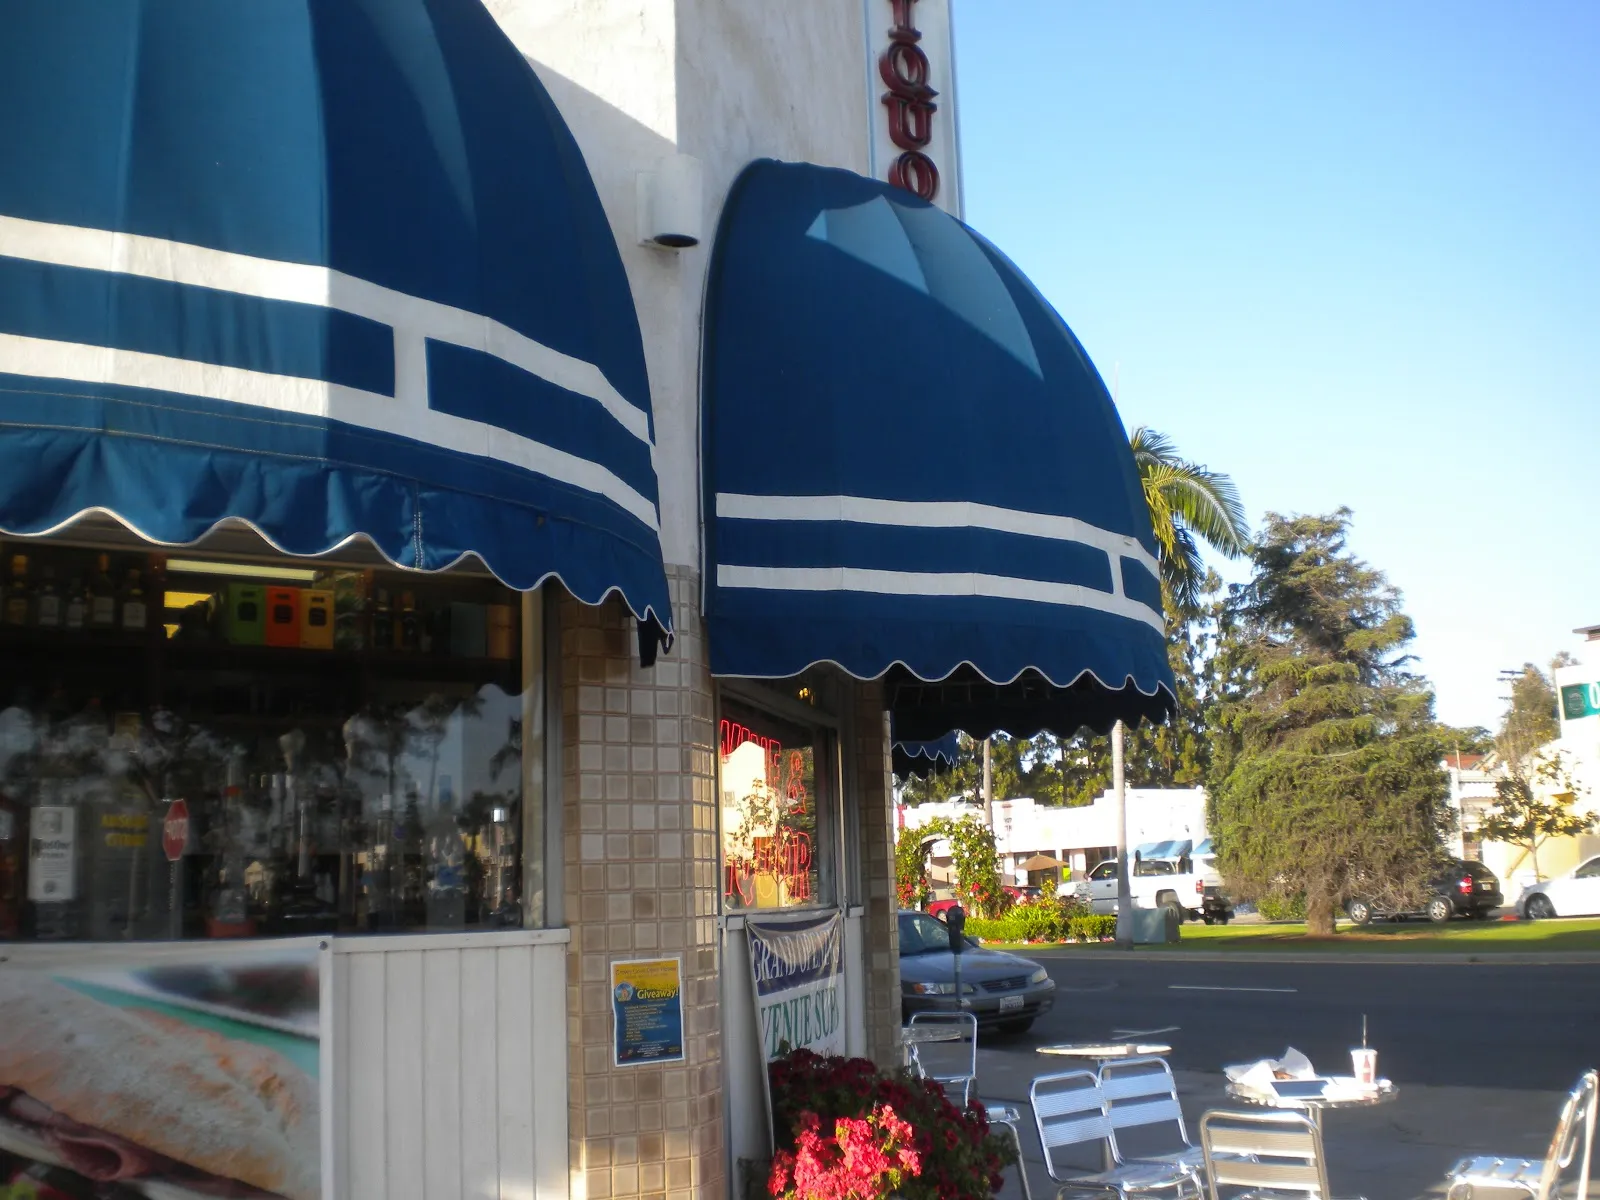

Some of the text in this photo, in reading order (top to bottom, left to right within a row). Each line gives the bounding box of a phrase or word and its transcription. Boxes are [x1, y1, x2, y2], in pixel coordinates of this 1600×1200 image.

[752, 935, 797, 983] GRAND
[637, 987, 679, 1000] Giveaway!
[760, 994, 812, 1058] VENUE
